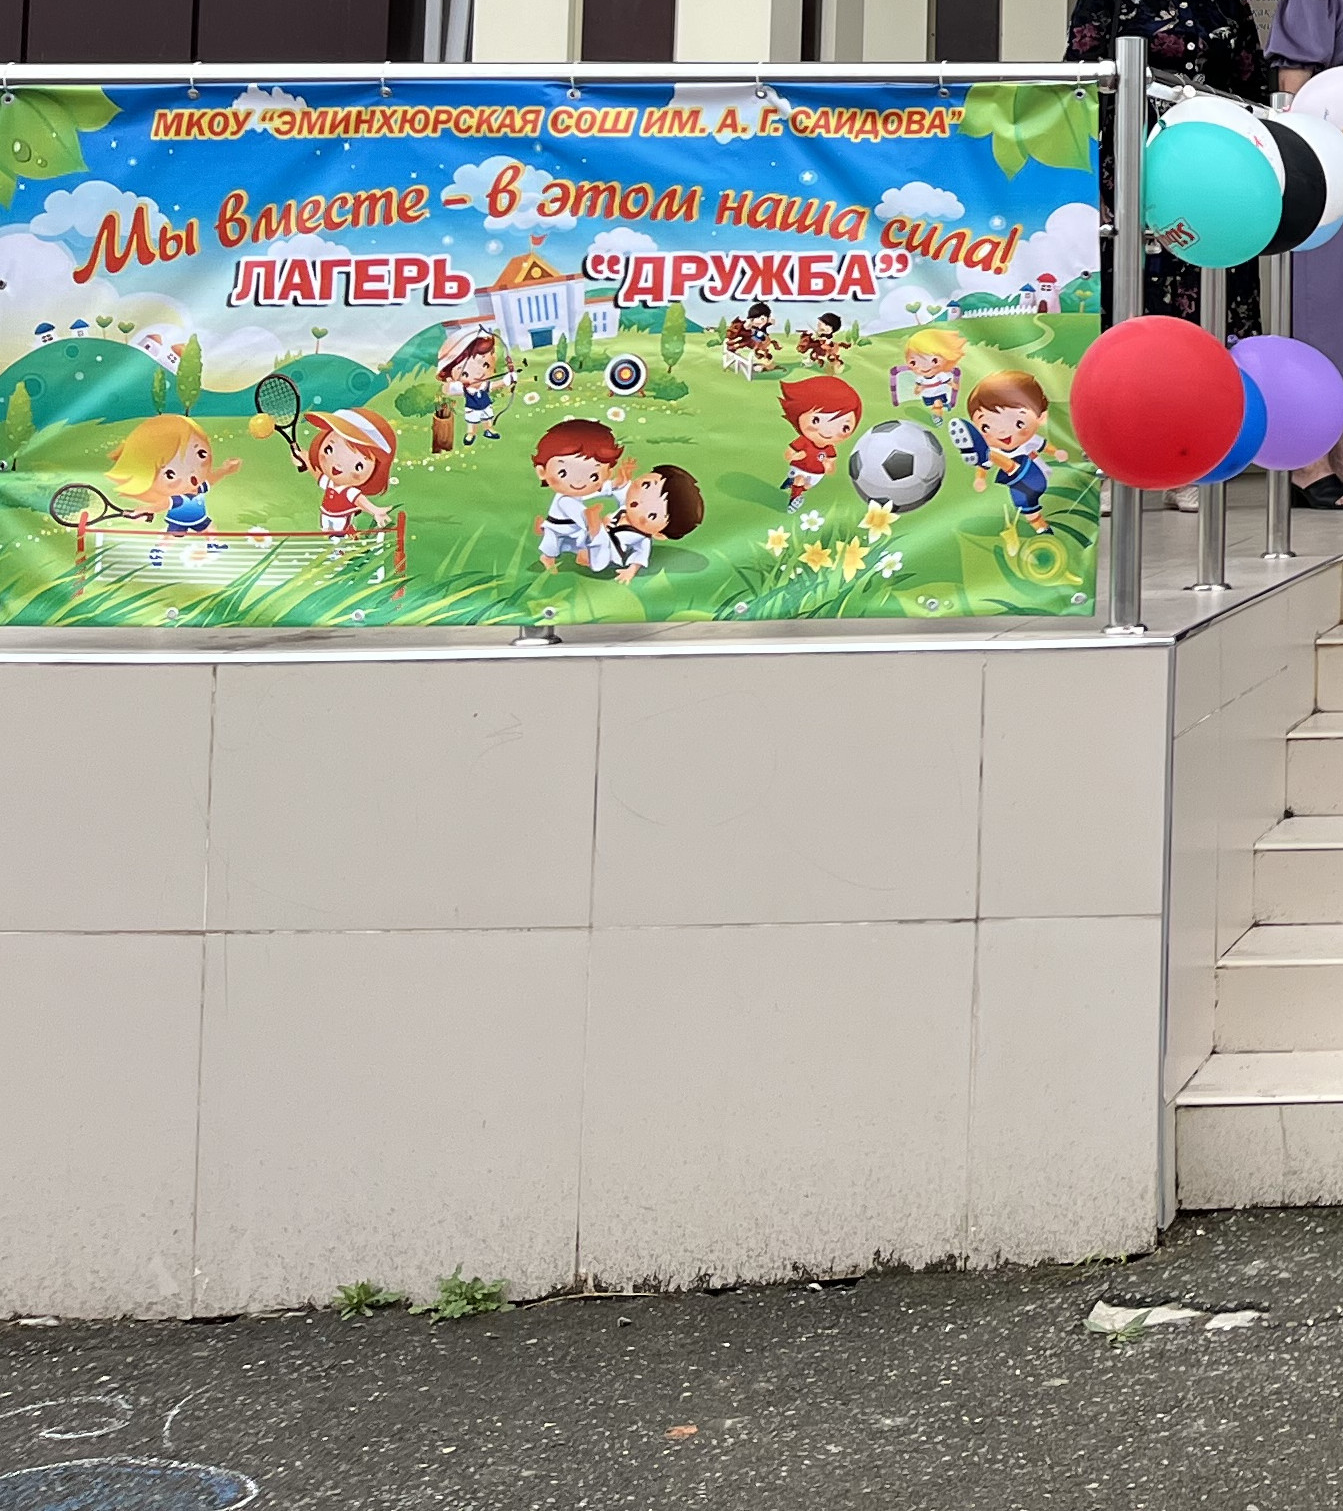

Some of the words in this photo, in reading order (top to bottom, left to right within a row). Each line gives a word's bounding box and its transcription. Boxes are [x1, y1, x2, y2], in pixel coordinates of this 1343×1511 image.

[152, 108, 251, 141] МКОУ
[549, 107, 639, 136] СОШ
[642, 107, 707, 136] ИМ.
[715, 107, 748, 136] А.
[758, 107, 784, 136] Г.
[73, 203, 198, 286] Мы
[215, 183, 431, 249] вместе
[487, 160, 526, 221] в
[536, 179, 702, 223] этом
[715, 189, 869, 242] наша
[880, 218, 1021, 277] сила!
[232, 257, 472, 303] ЛАГЕРЬ
